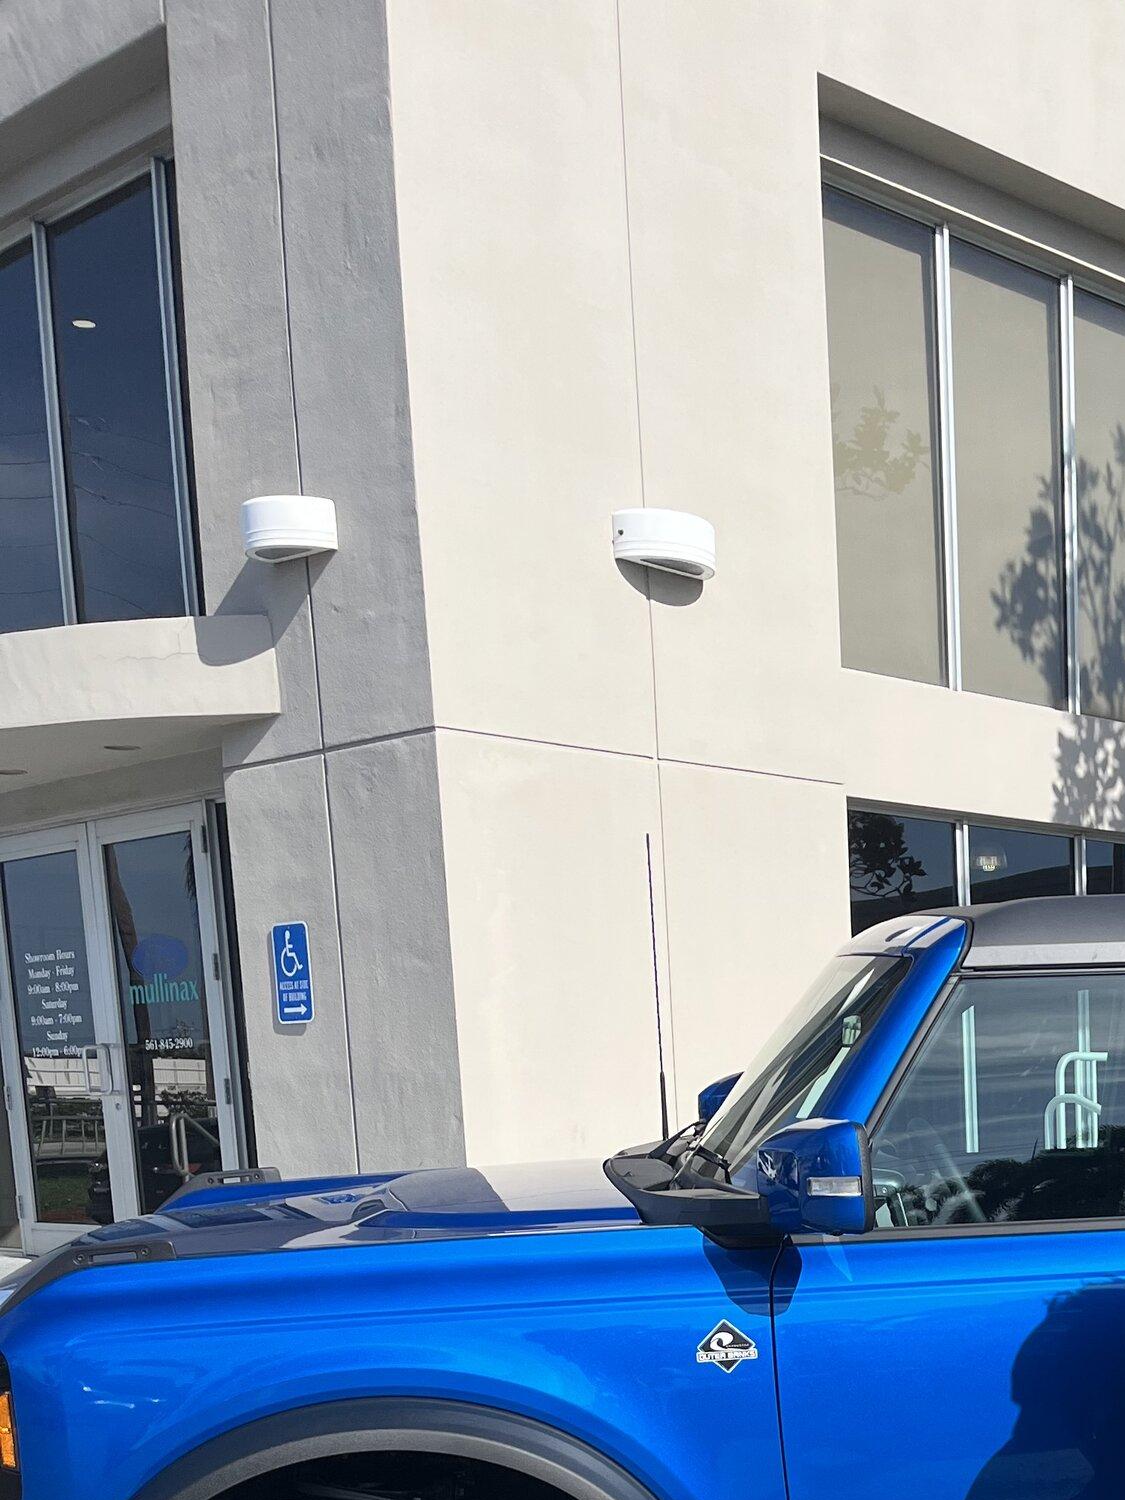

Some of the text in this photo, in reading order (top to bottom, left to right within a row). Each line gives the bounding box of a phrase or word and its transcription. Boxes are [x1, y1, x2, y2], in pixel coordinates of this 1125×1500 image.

[28, 967, 51, 980] Monday
[56, 965, 74, 977] Friday
[129, 973, 199, 1005] mullinax
[42, 998, 68, 1010] Saturday
[46, 1029, 69, 1042] Sunday
[63, 1044, 83, 1057] 6:00p
[145, 1036, 194, 1051] 561-845-2900
